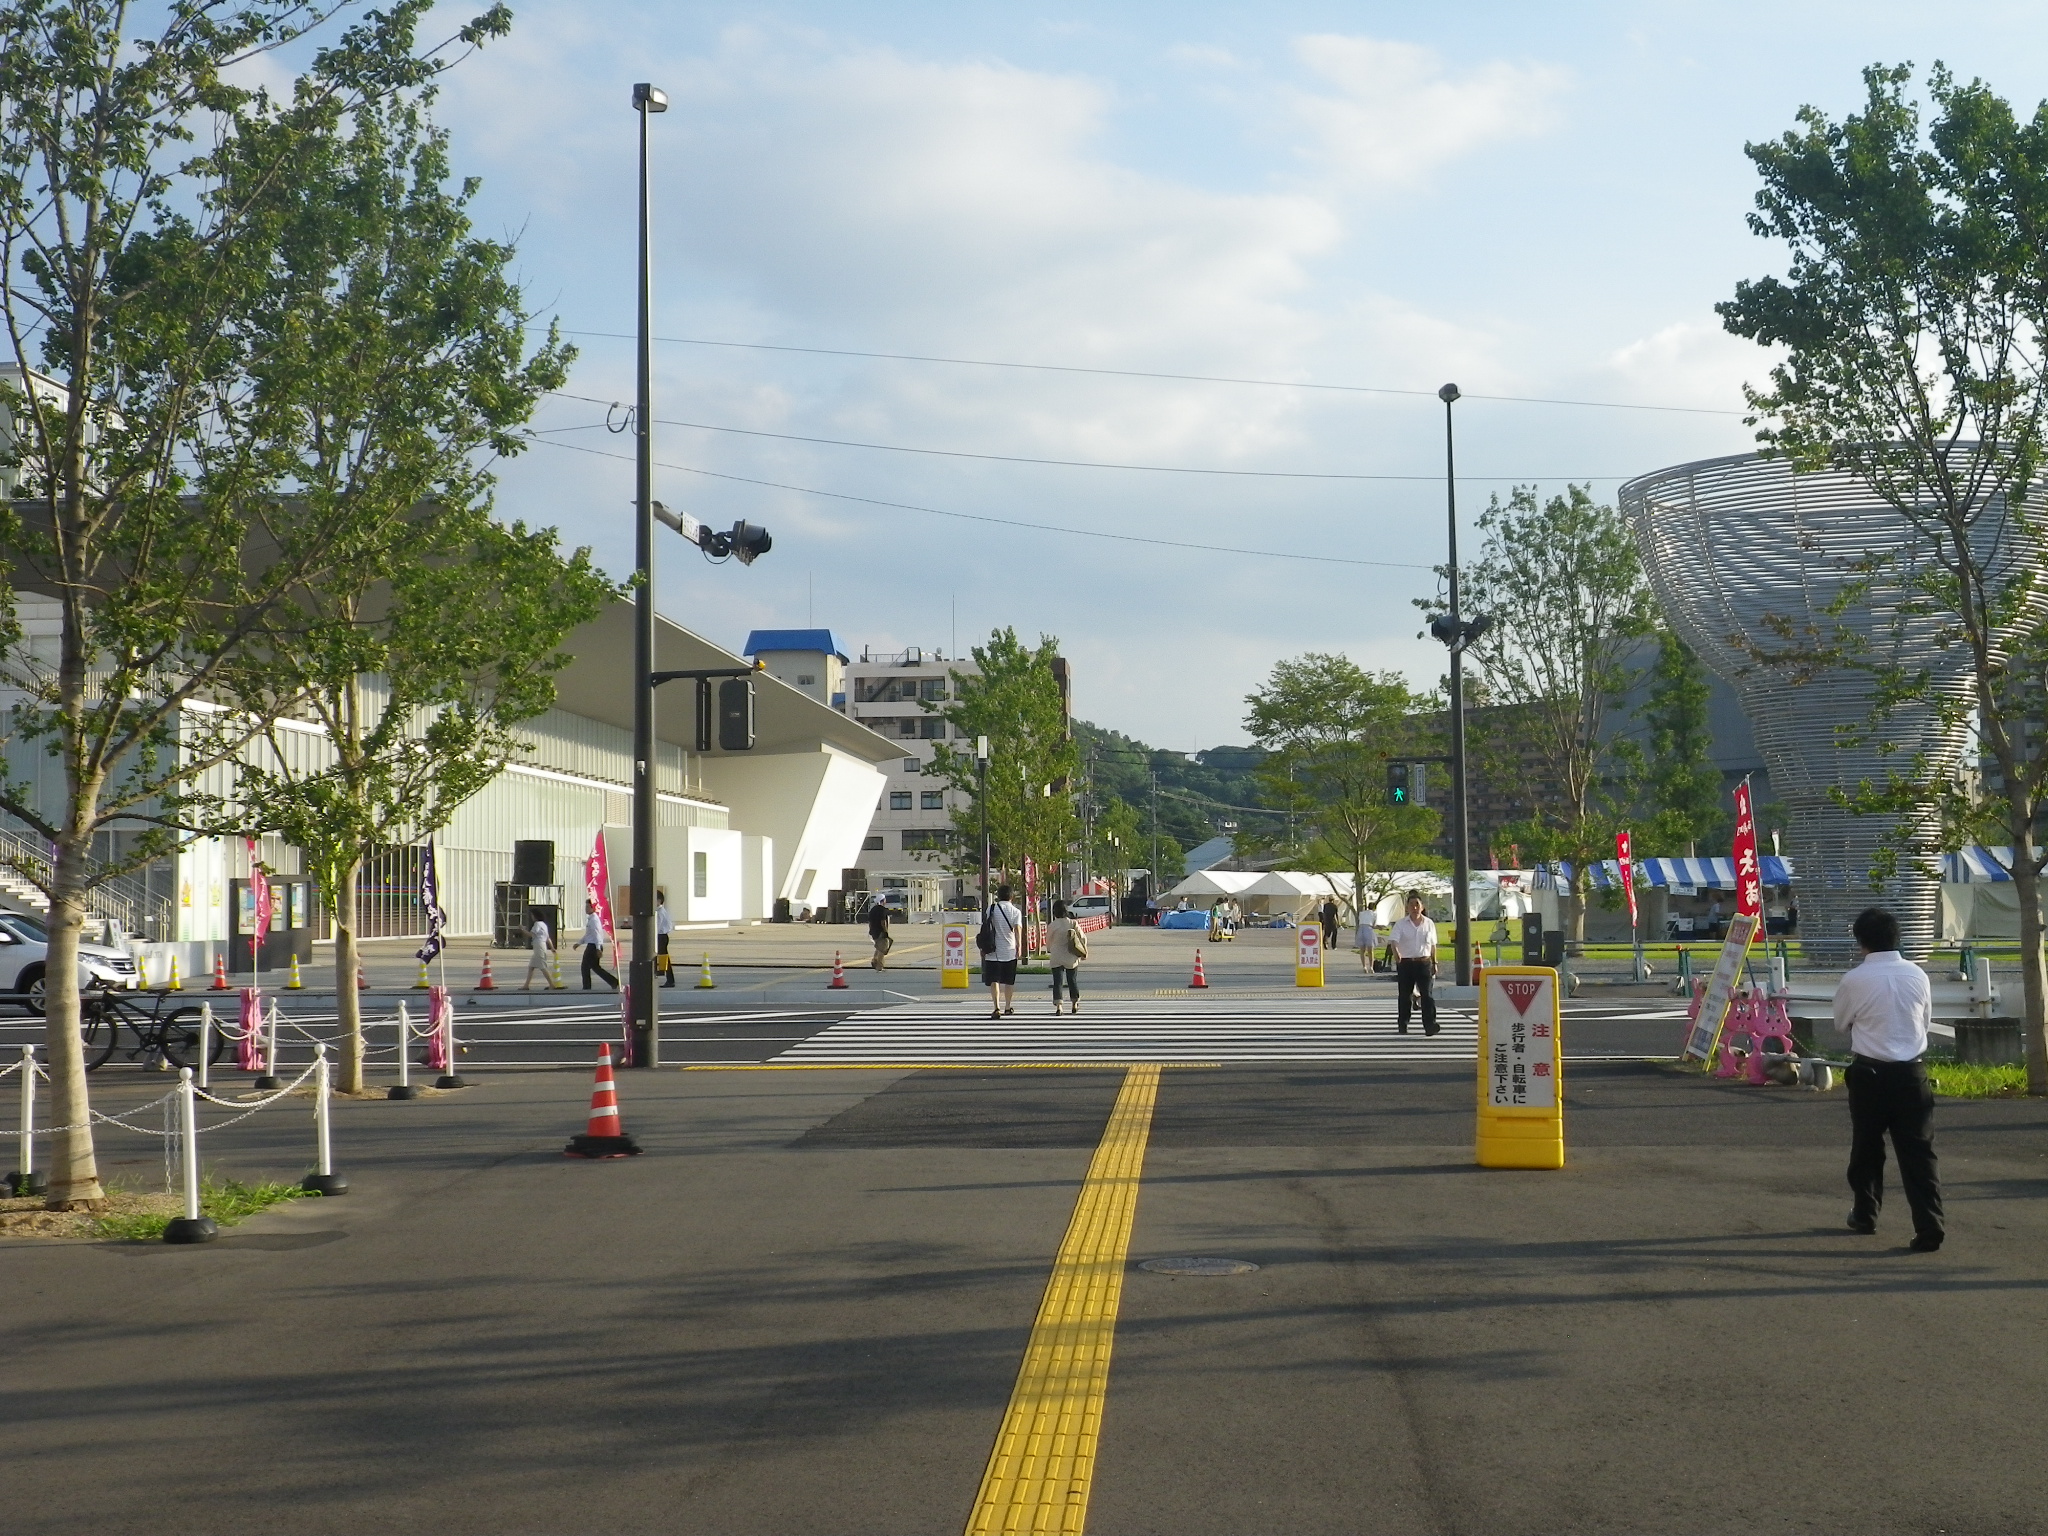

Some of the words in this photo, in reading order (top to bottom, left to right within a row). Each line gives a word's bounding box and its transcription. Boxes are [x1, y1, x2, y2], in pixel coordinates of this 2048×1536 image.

[1507, 983, 1536, 995] STOP
[1494, 1043, 1509, 1104] ご注意下さい
[1511, 1022, 1526, 1104] 歩行者・自転車に
[1531, 1023, 1551, 1077] 注意
